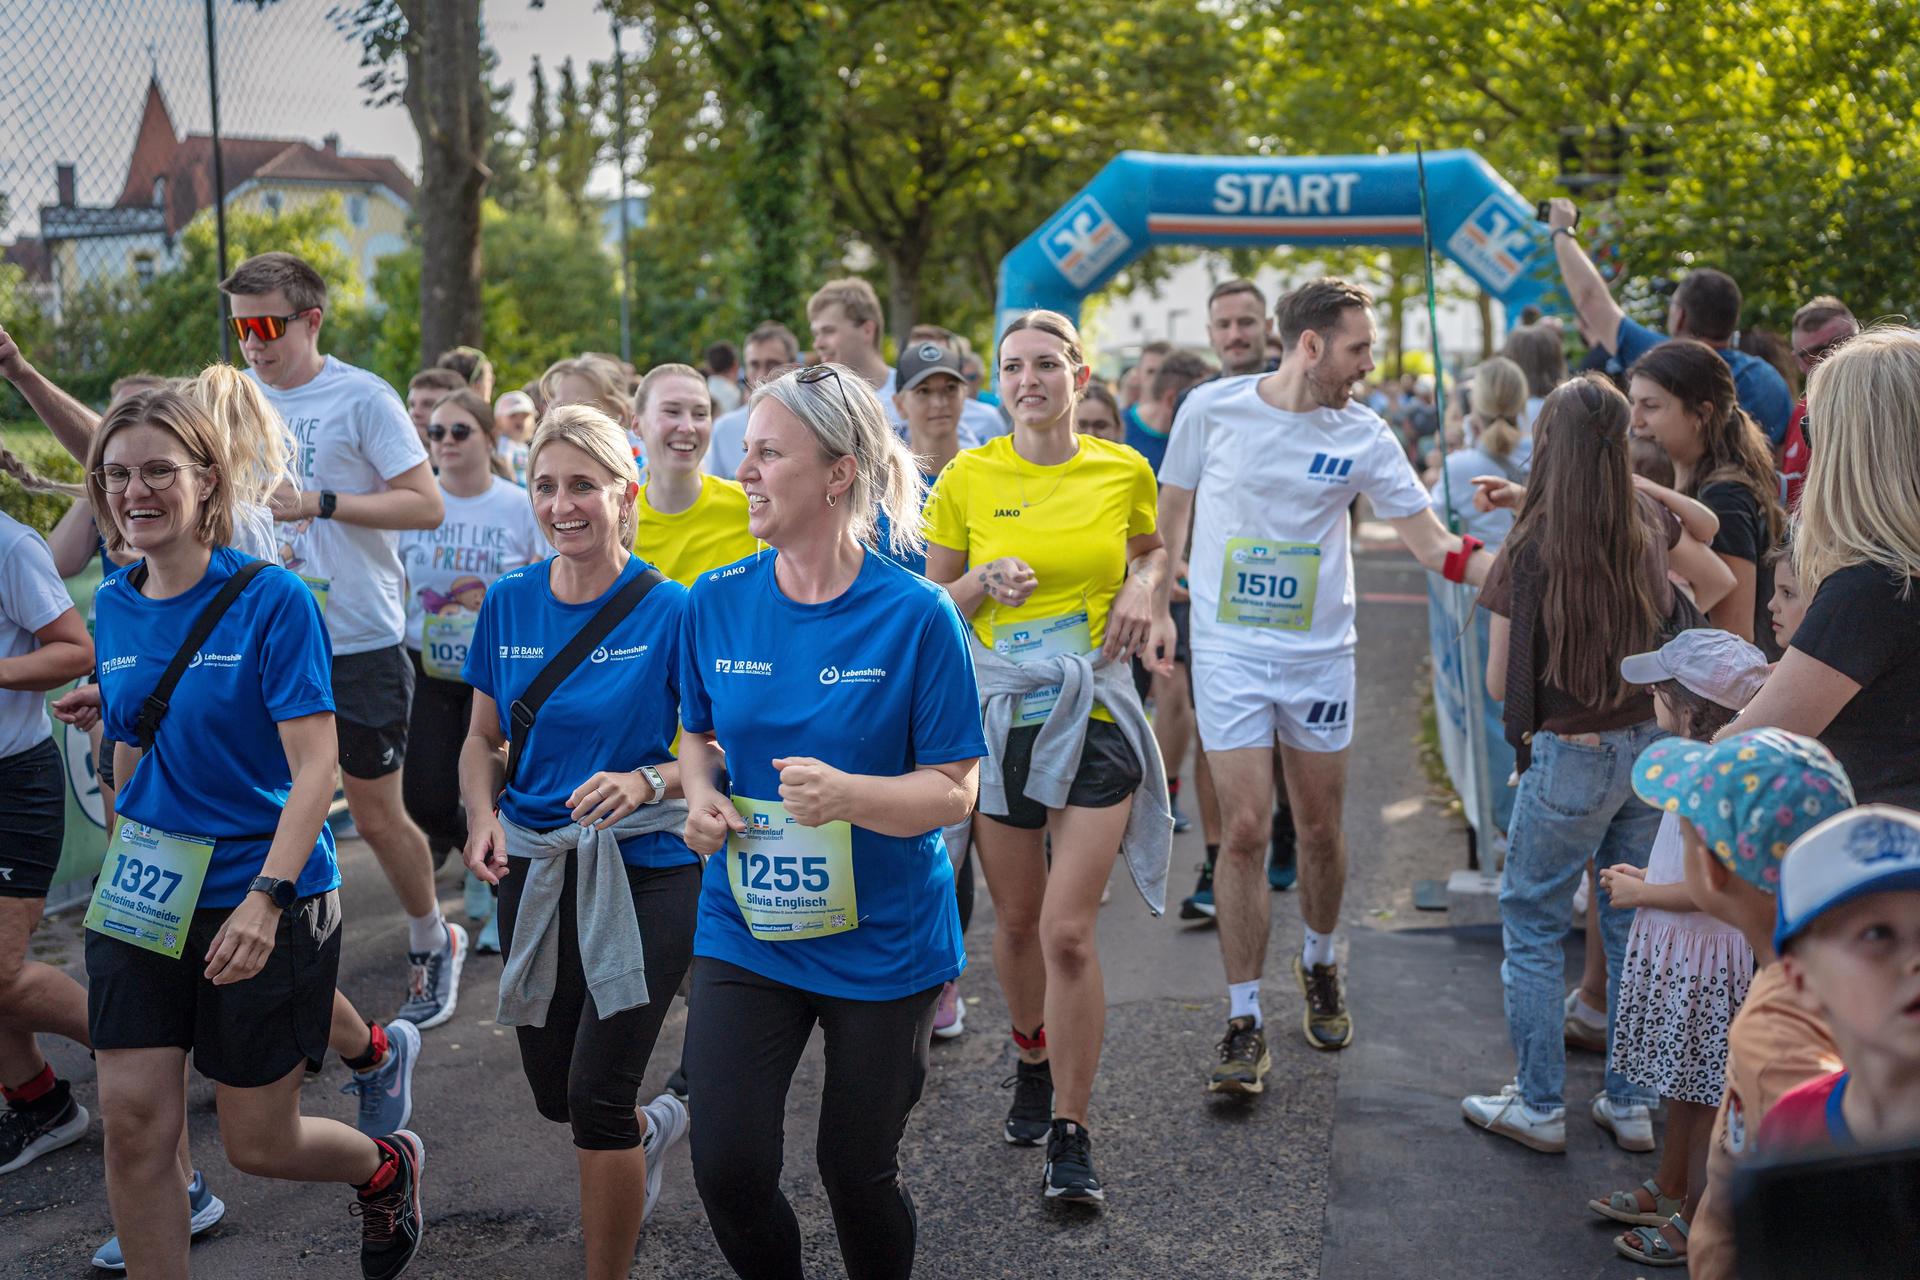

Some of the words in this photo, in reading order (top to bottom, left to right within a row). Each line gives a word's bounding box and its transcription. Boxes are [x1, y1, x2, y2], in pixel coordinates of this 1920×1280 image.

[1214, 173, 1360, 214] START
[287, 417, 320, 445] LIKE
[993, 509, 1021, 518] JAKO
[417, 522, 466, 545] FIGHT
[472, 525, 507, 549] LIKE
[432, 546, 505, 573] PREEMIE
[506, 571, 524, 580] JAKO
[721, 566, 746, 578] JAKO
[99, 579, 116, 590] AKO
[1237, 571, 1298, 600] 1510
[510, 646, 520, 655] VR
[521, 646, 544, 655] BANK
[117, 655, 138, 666] BANK
[734, 660, 745, 670] VR
[746, 661, 773, 672] BANK
[841, 667, 886, 678] Lebenshilfe
[749, 827, 784, 836] Firmenlauf
[111, 854, 183, 904] 1327
[738, 851, 830, 893] 1255
[100, 888, 136, 909] Christina
[136, 901, 181, 923] Schneider
[746, 893, 773, 907] Silvia
[775, 896, 827, 910] Englisch
